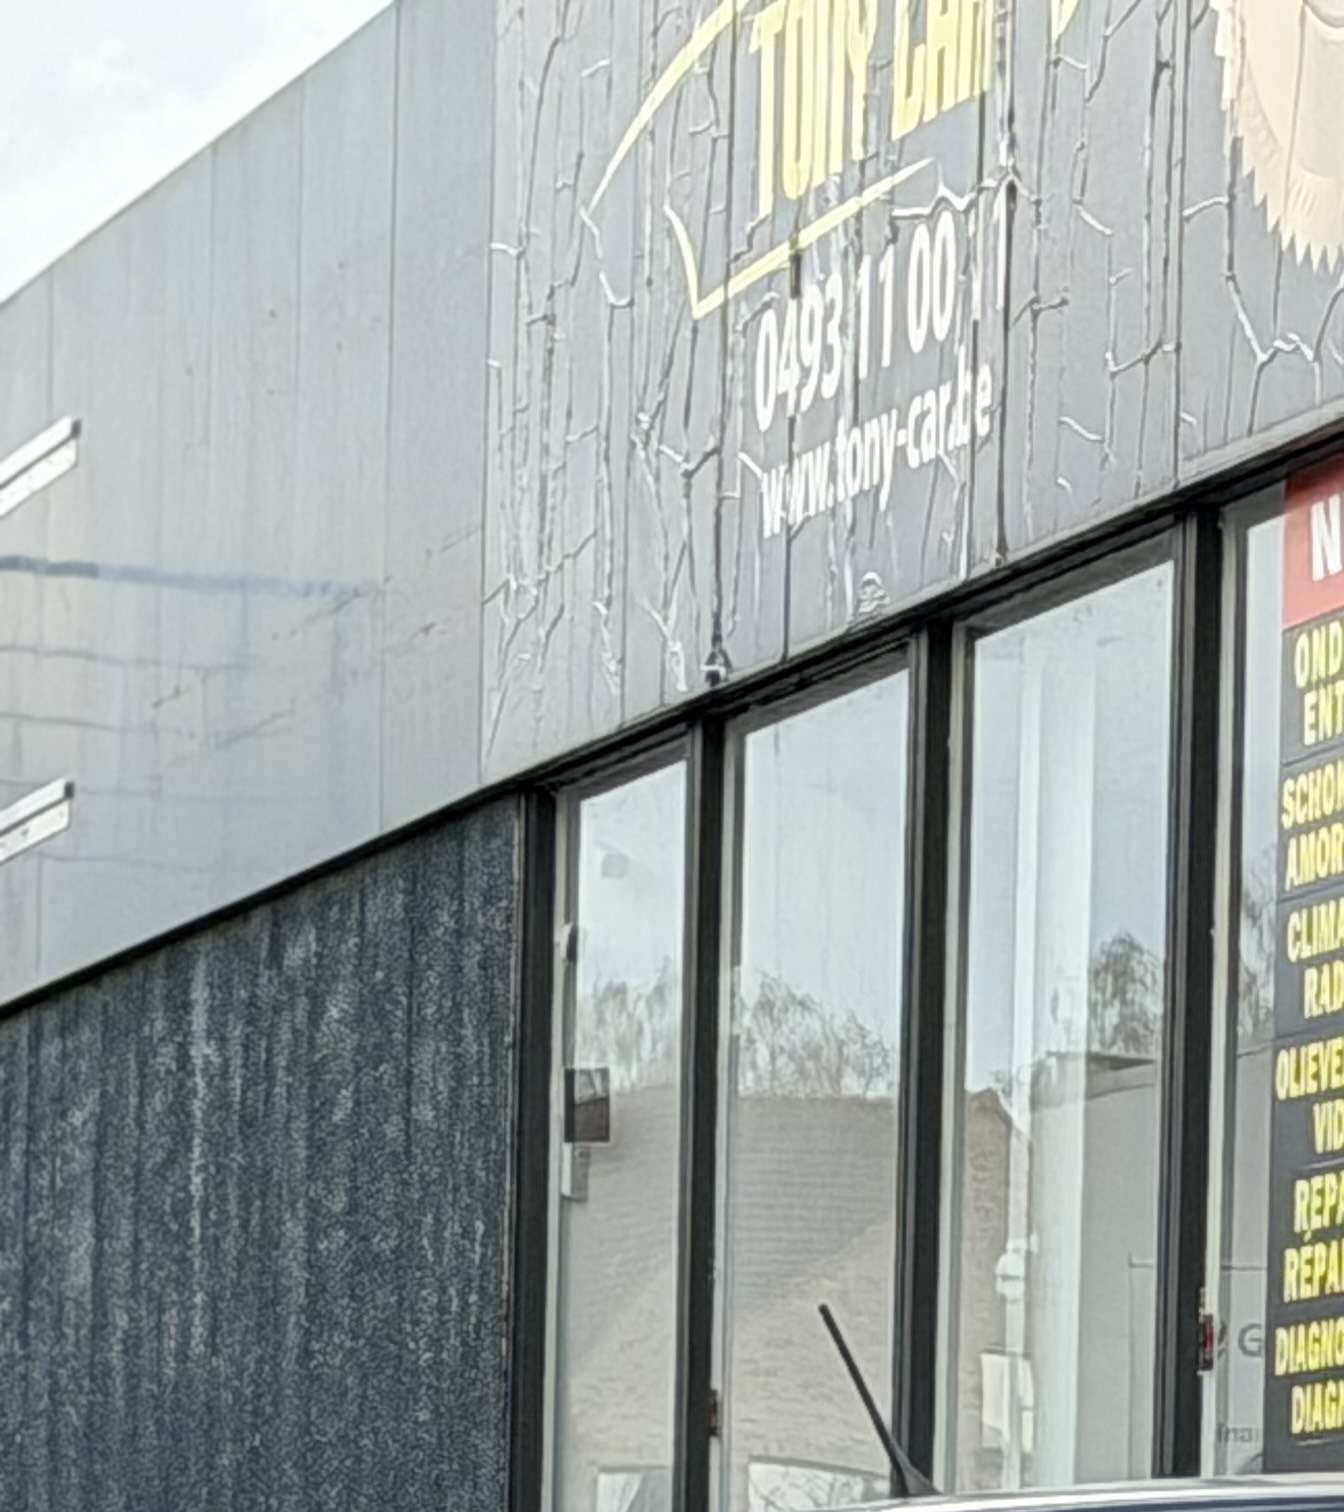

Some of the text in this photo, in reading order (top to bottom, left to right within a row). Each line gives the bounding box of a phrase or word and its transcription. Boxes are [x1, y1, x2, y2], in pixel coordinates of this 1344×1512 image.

[756, 272, 843, 432] 0493
[857, 243, 894, 380] 11
[908, 210, 956, 353] 00
